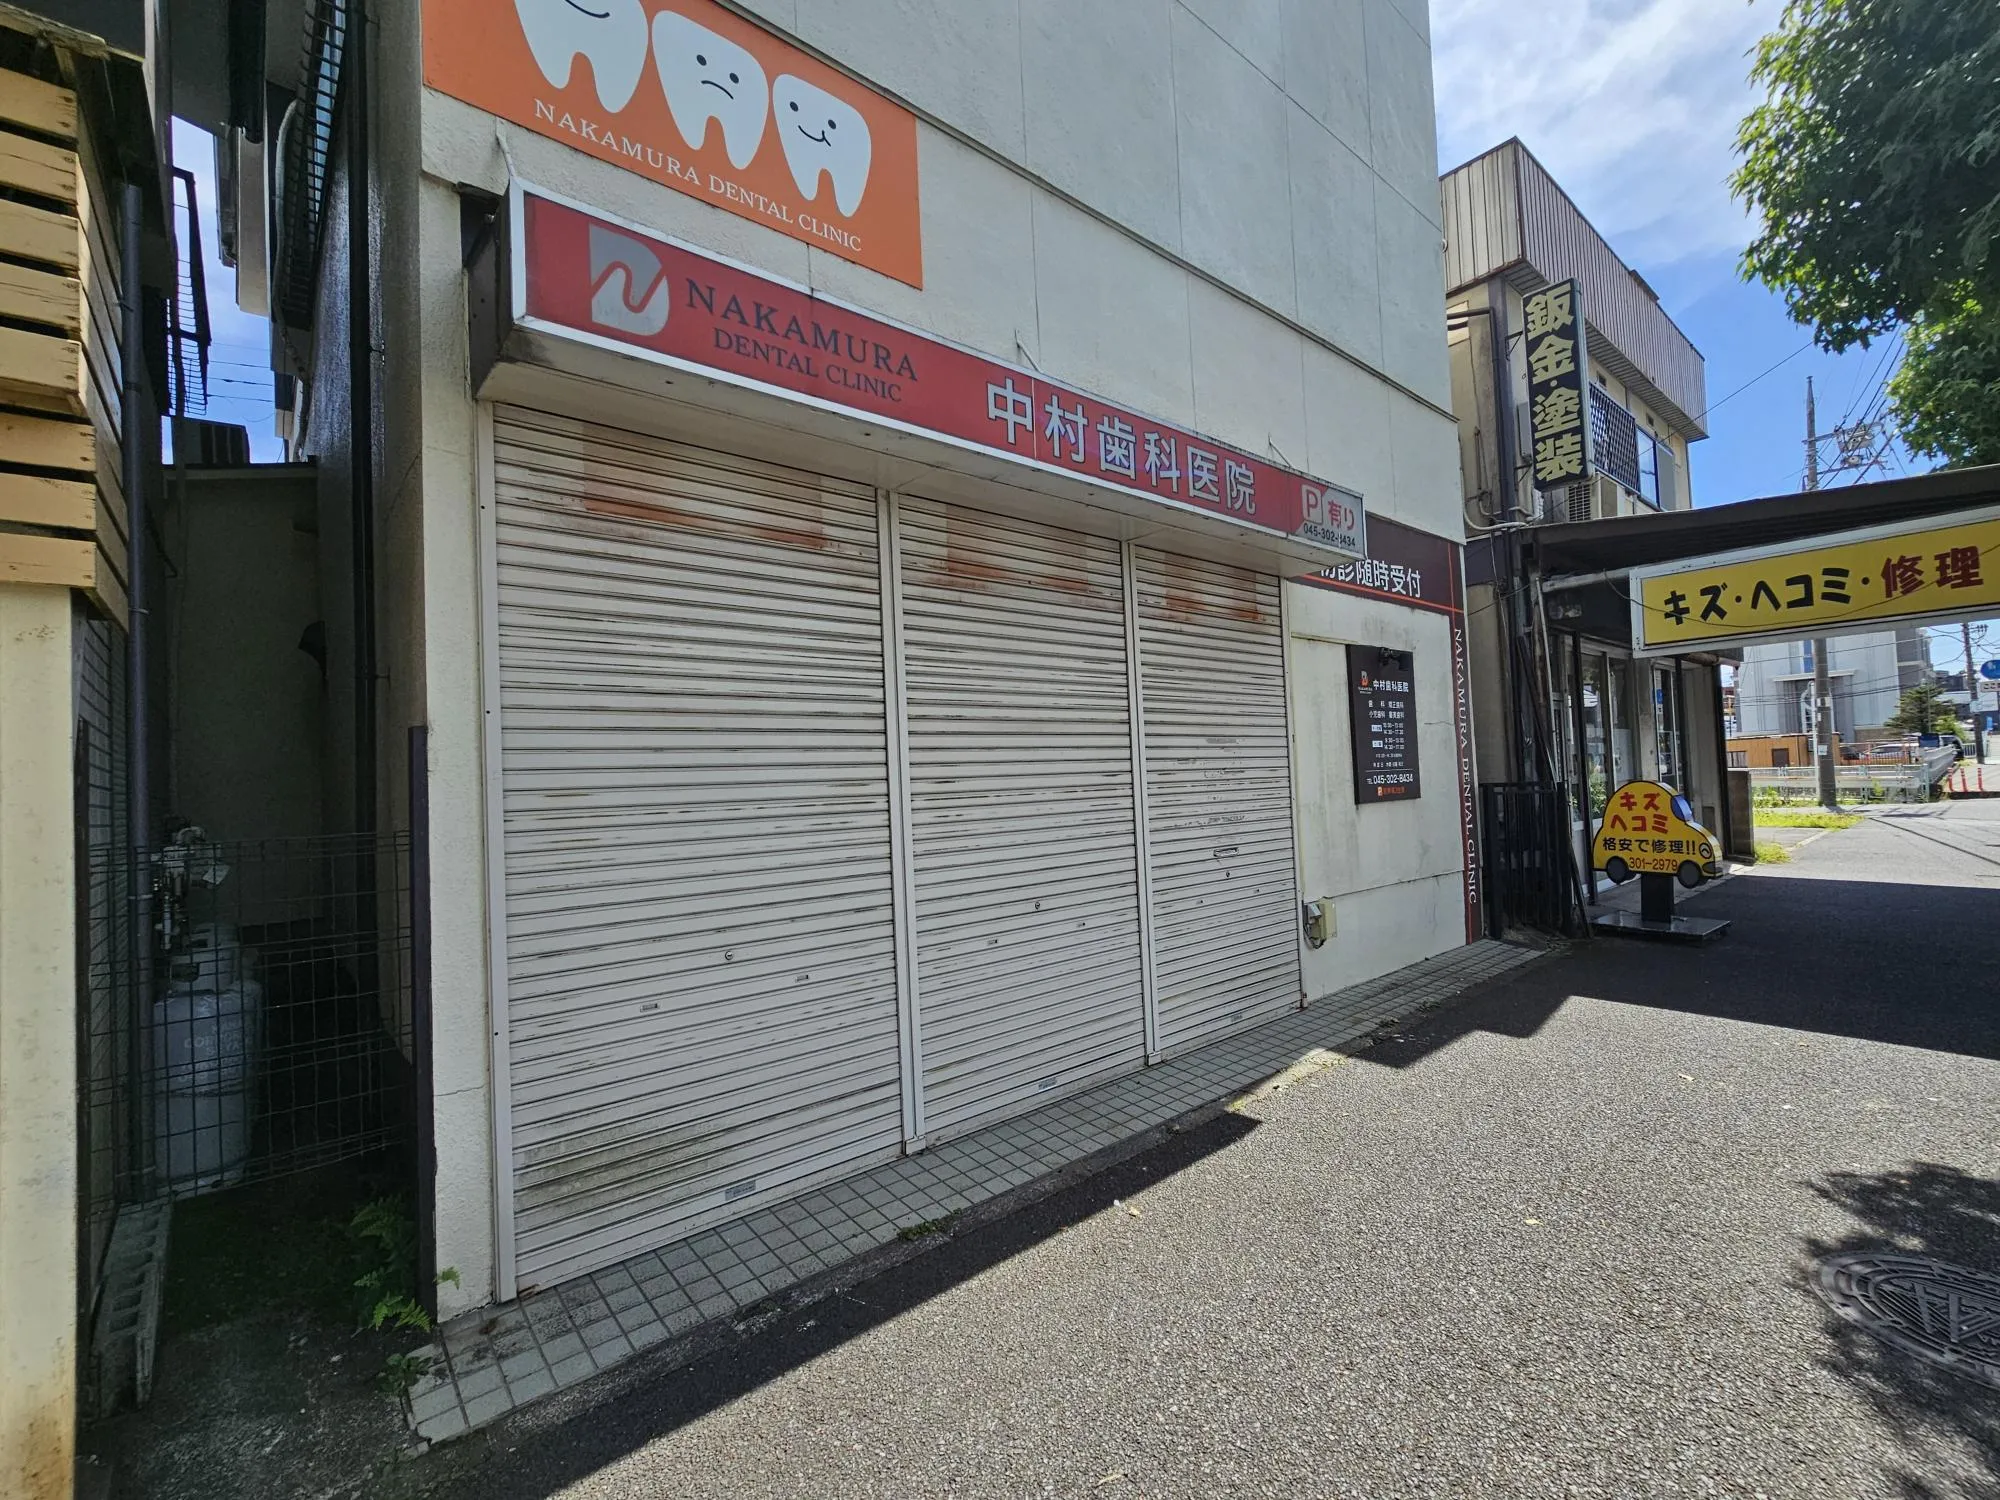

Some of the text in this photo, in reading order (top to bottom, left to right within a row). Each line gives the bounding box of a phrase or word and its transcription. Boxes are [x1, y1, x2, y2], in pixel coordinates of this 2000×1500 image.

[534, 98, 862, 252] NAKAMURA DENTAL CLINIC
[685, 277, 918, 382] NAKAMURA
[713, 327, 903, 402] DENTAL CLINIC
[986, 376, 1257, 515] 中村歯科医院
[1454, 628, 1477, 904] NAKAMURA DENTAL CLINIC
[1620, 791, 1661, 812] キズ
[1610, 813, 1669, 834] ヘコミ
[1628, 856, 1678, 872] 301-2979
